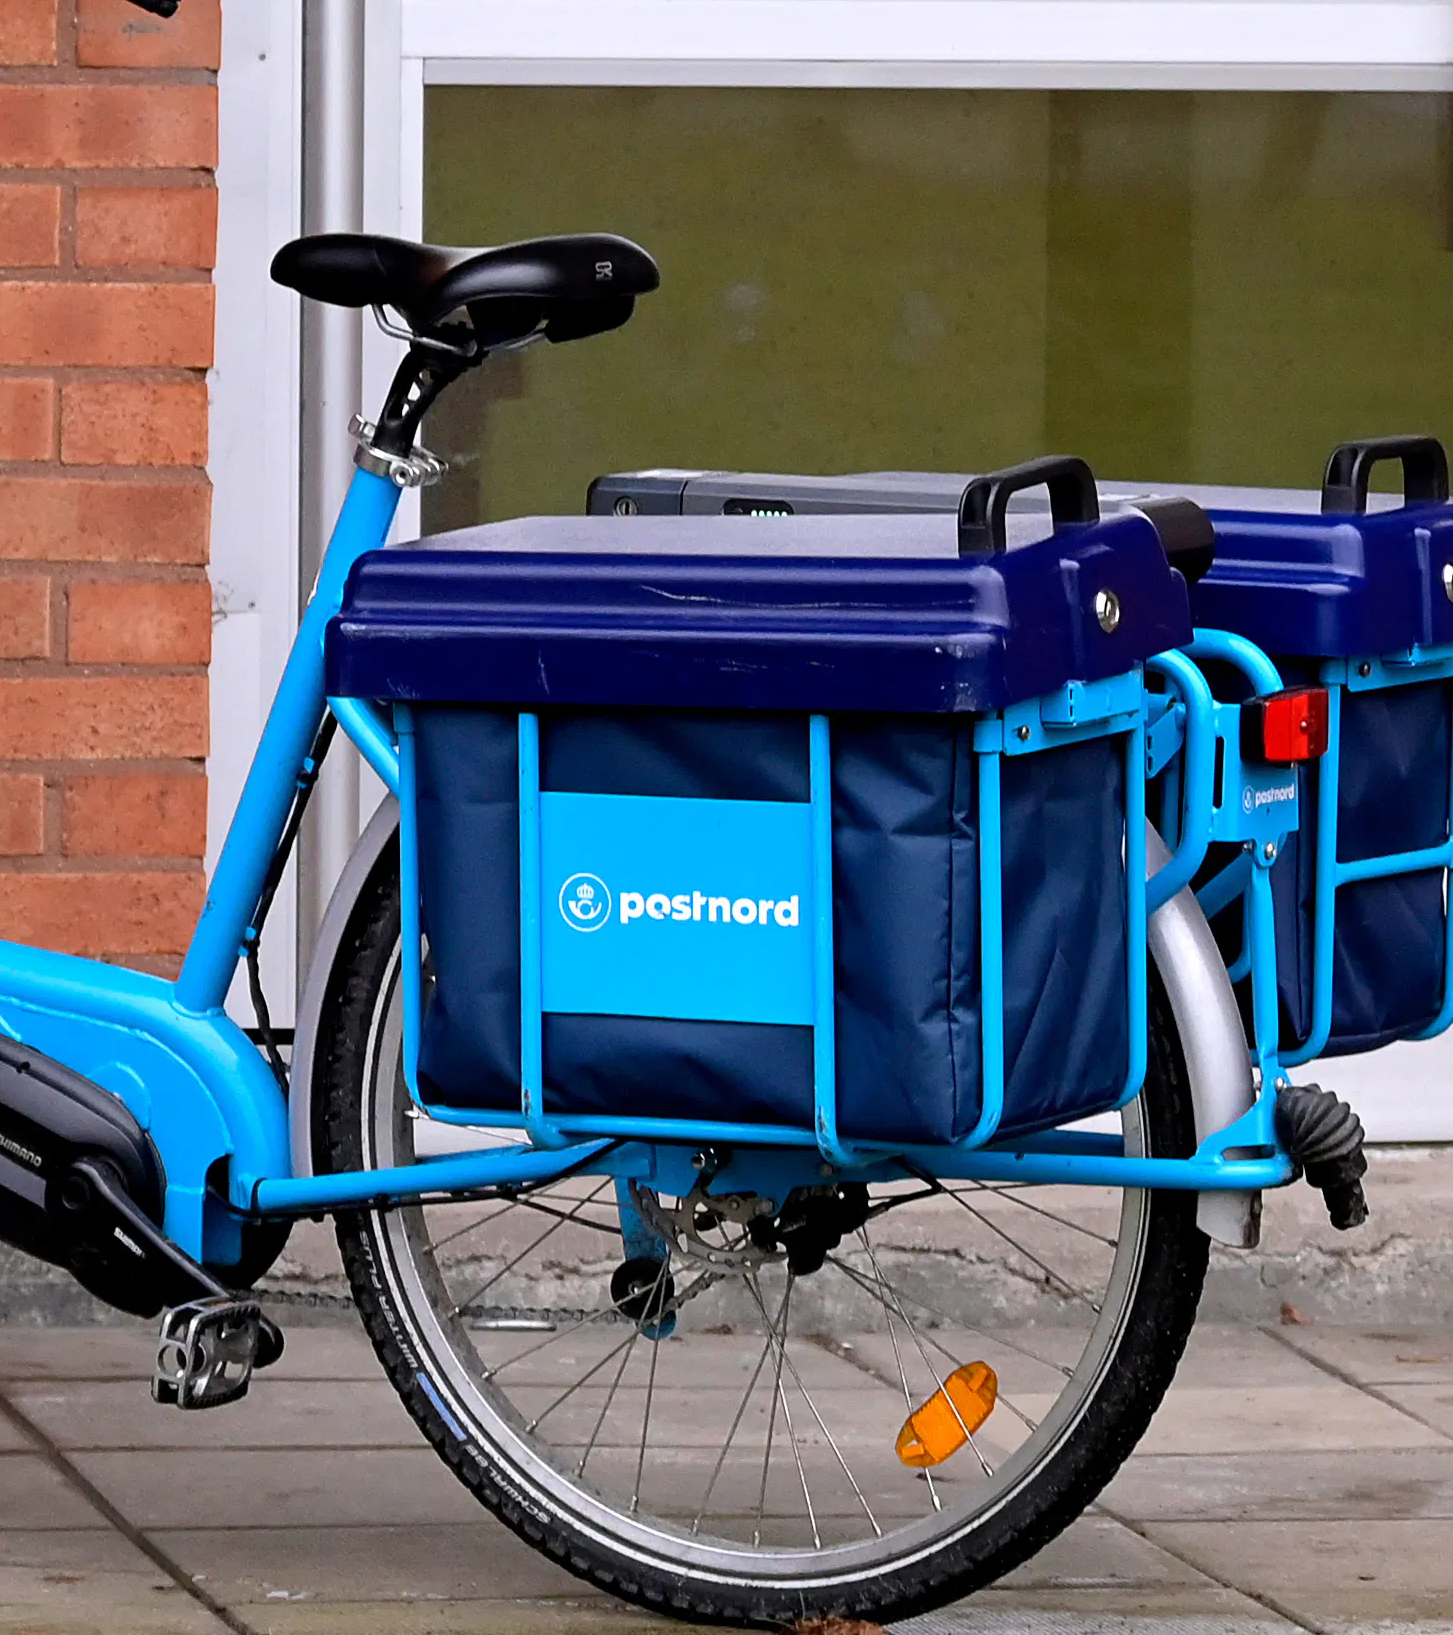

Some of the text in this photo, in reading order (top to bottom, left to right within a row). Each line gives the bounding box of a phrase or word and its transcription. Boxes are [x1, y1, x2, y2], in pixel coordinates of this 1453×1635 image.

[1255, 783, 1295, 808] postnord
[619, 890, 799, 926] postnord
[359, 1230, 418, 1368] WINTER PLUS
[466, 1444, 550, 1524] SCHWALBE
